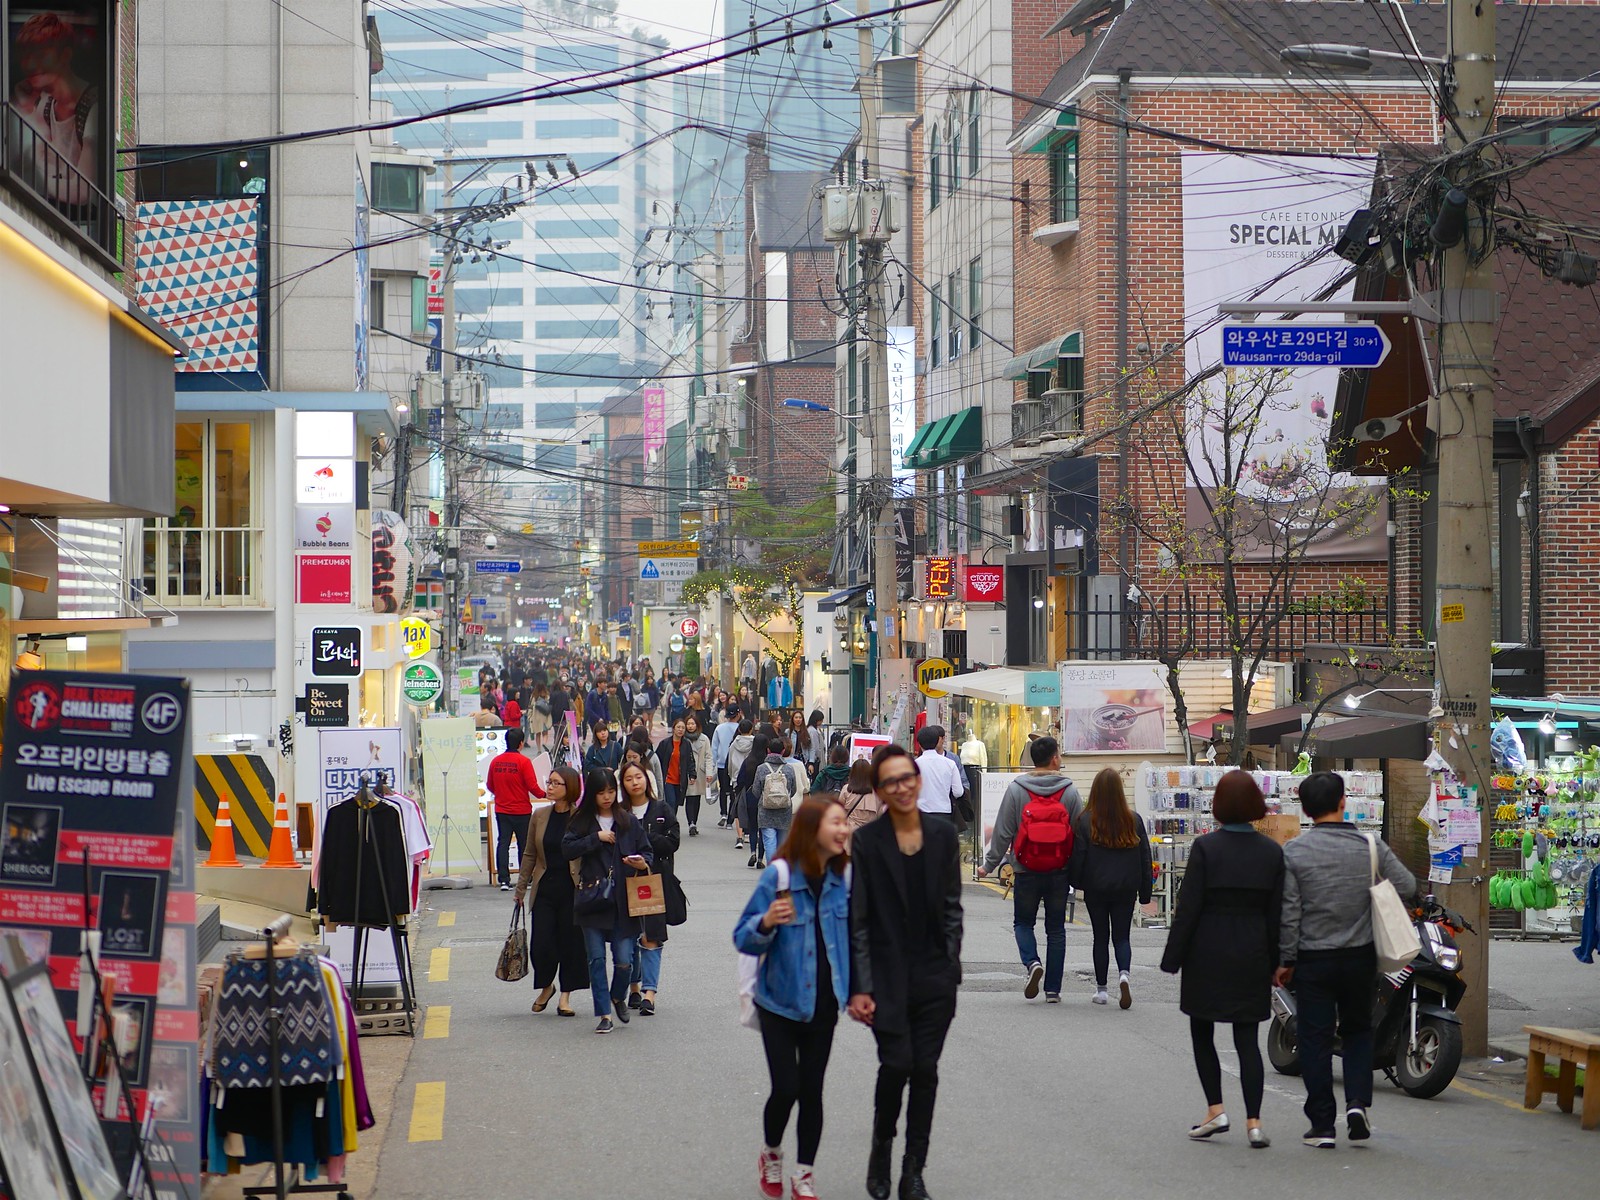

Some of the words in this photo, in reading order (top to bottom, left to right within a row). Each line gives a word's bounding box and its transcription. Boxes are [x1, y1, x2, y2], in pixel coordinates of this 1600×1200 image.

[1261, 212, 1291, 221] CAFE
[1296, 211, 1345, 221] ETONNE
[1229, 224, 1312, 246] SPECIAL
[1266, 250, 1298, 258] DESSERT
[1227, 330, 1348, 348] 와우산로29다길
[1353, 337, 1365, 346] 30
[1228, 351, 1291, 362] Wausan-ro
[1294, 351, 1341, 364] 29da-gil
[302, 558, 350, 566] PREMIUM89
[921, 666, 951, 685] Max
[310, 688, 328, 698] Be.
[310, 697, 343, 708] Sweet
[61, 700, 134, 721] CHALLENGE
[145, 702, 176, 725] 4F
[310, 707, 325, 716] On
[15, 742, 171, 777] 오프라인방탈출
[26, 773, 56, 793] Live
[58, 775, 111, 797] Escape
[111, 778, 154, 799] Room
[3, 862, 51, 875] SHERLOCK
[107, 927, 144, 943] LOST
